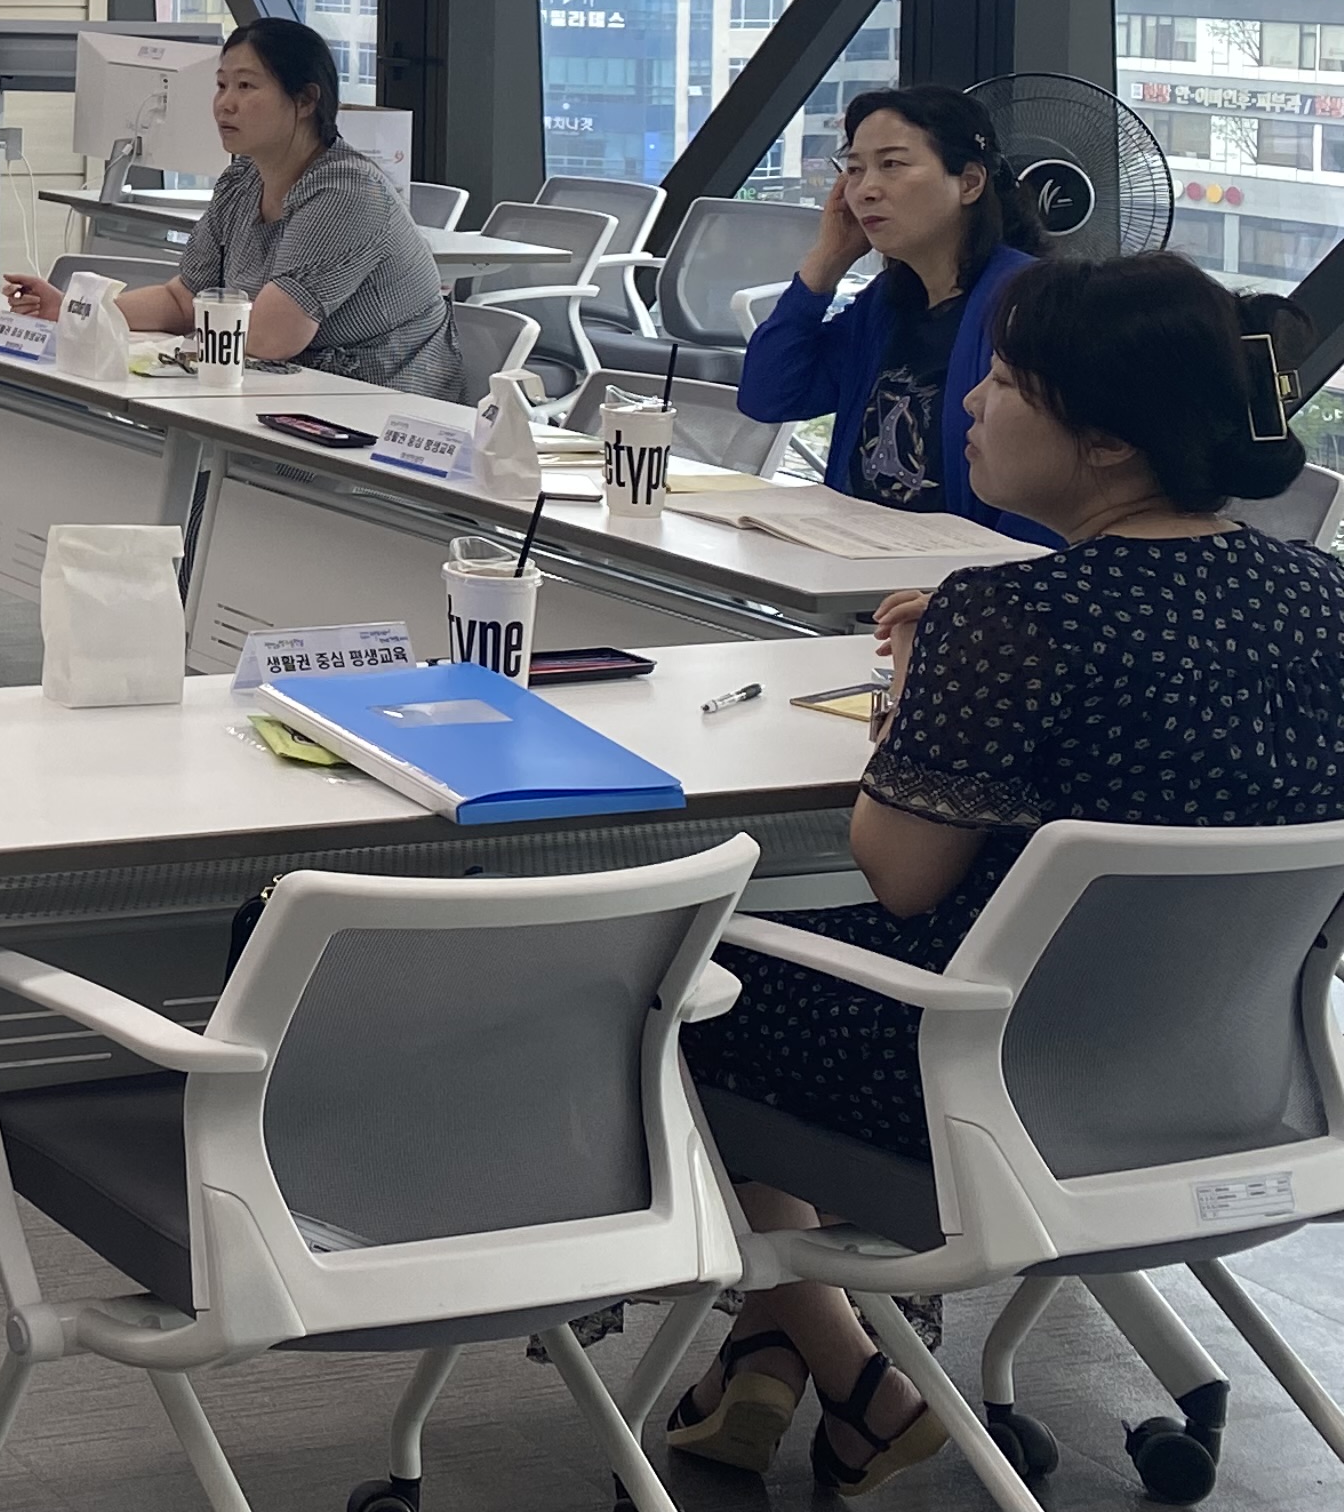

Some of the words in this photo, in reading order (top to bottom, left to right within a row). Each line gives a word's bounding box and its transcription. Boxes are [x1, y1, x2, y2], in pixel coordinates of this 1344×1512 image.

[265, 653, 312, 674] 생활권
[315, 650, 346, 670] 중심
[349, 646, 409, 668] 평생교육
